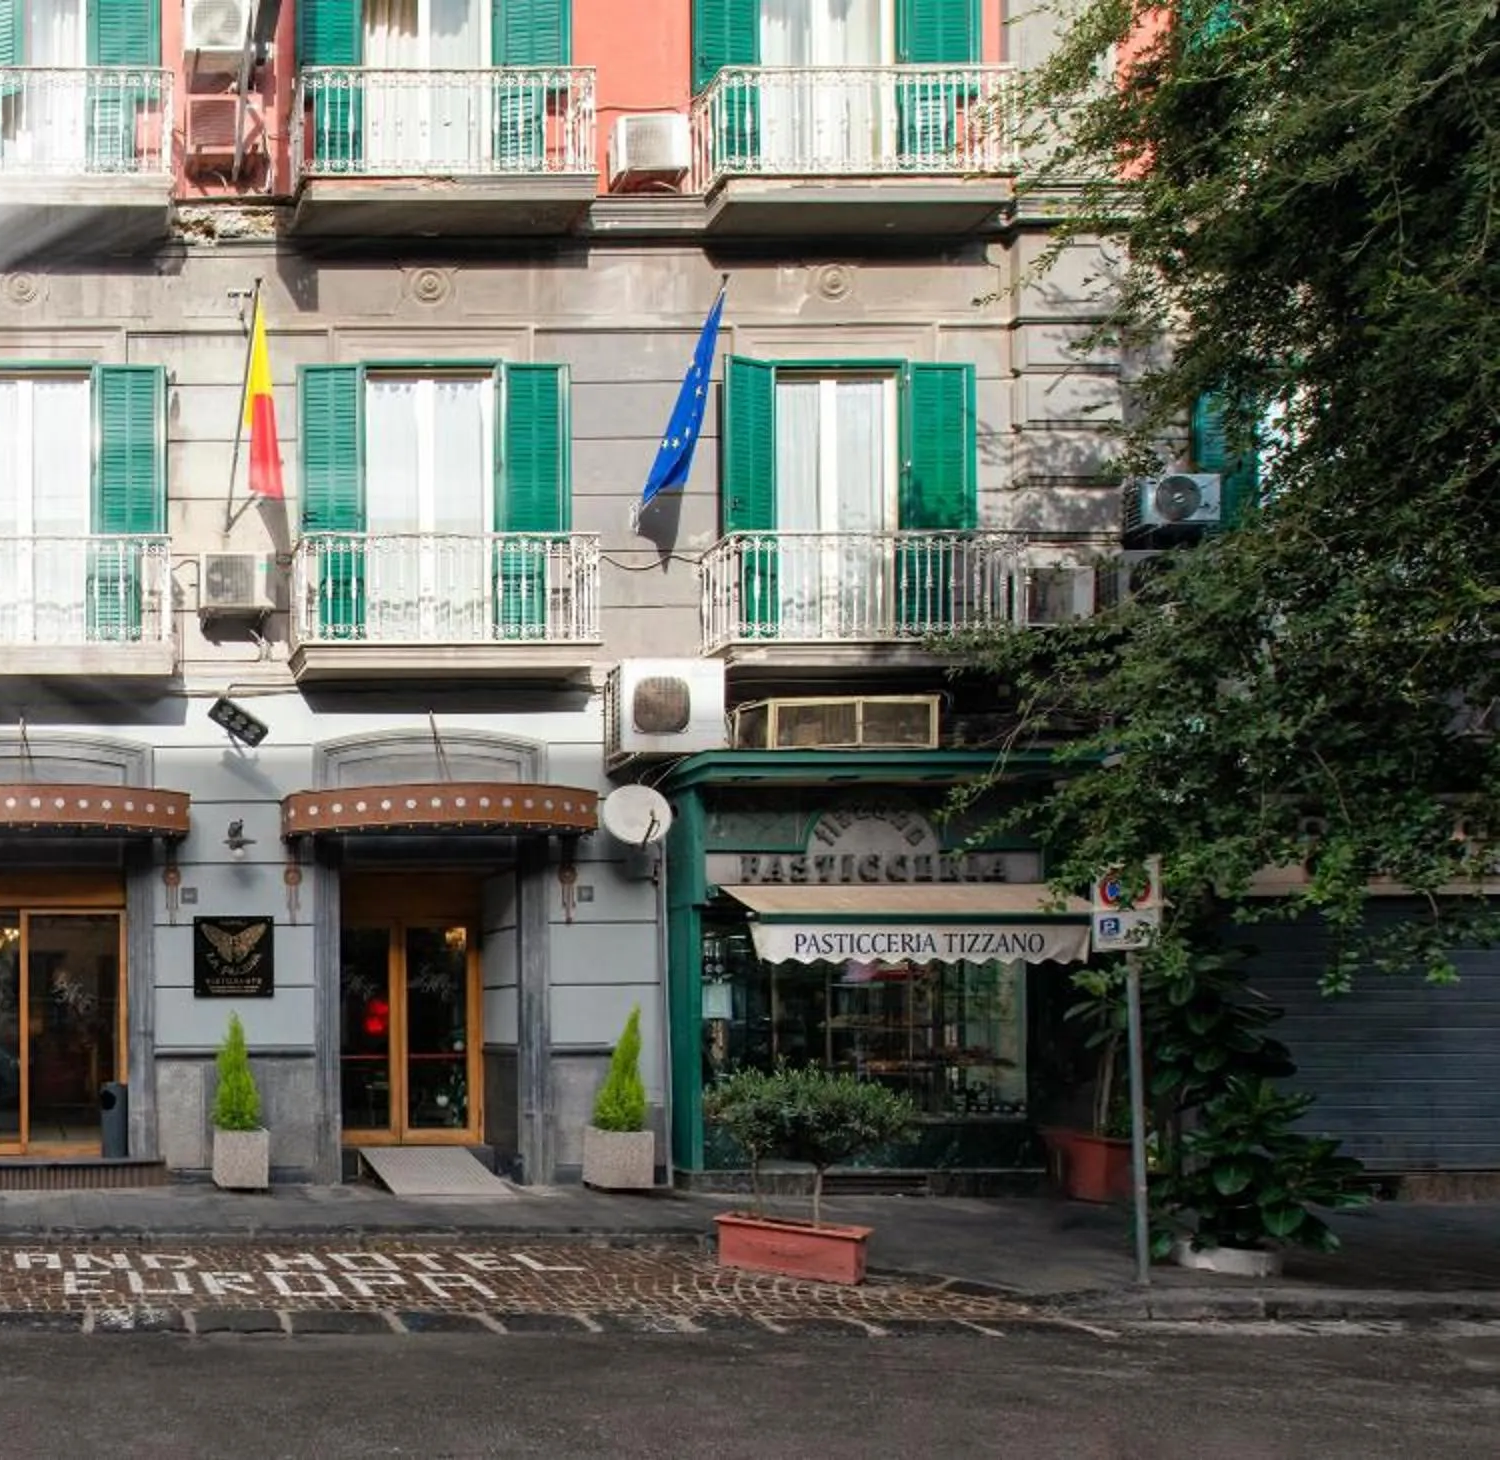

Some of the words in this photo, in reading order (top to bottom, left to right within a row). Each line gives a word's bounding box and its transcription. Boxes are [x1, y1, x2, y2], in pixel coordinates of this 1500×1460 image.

[739, 853, 1007, 883] PASTICCERIA
[795, 933, 937, 955] PASTICCERIA
[944, 932, 1046, 954] TIZZANO
[264, 1252, 585, 1271] HOTEL
[63, 1270, 499, 1299] EUROPA
